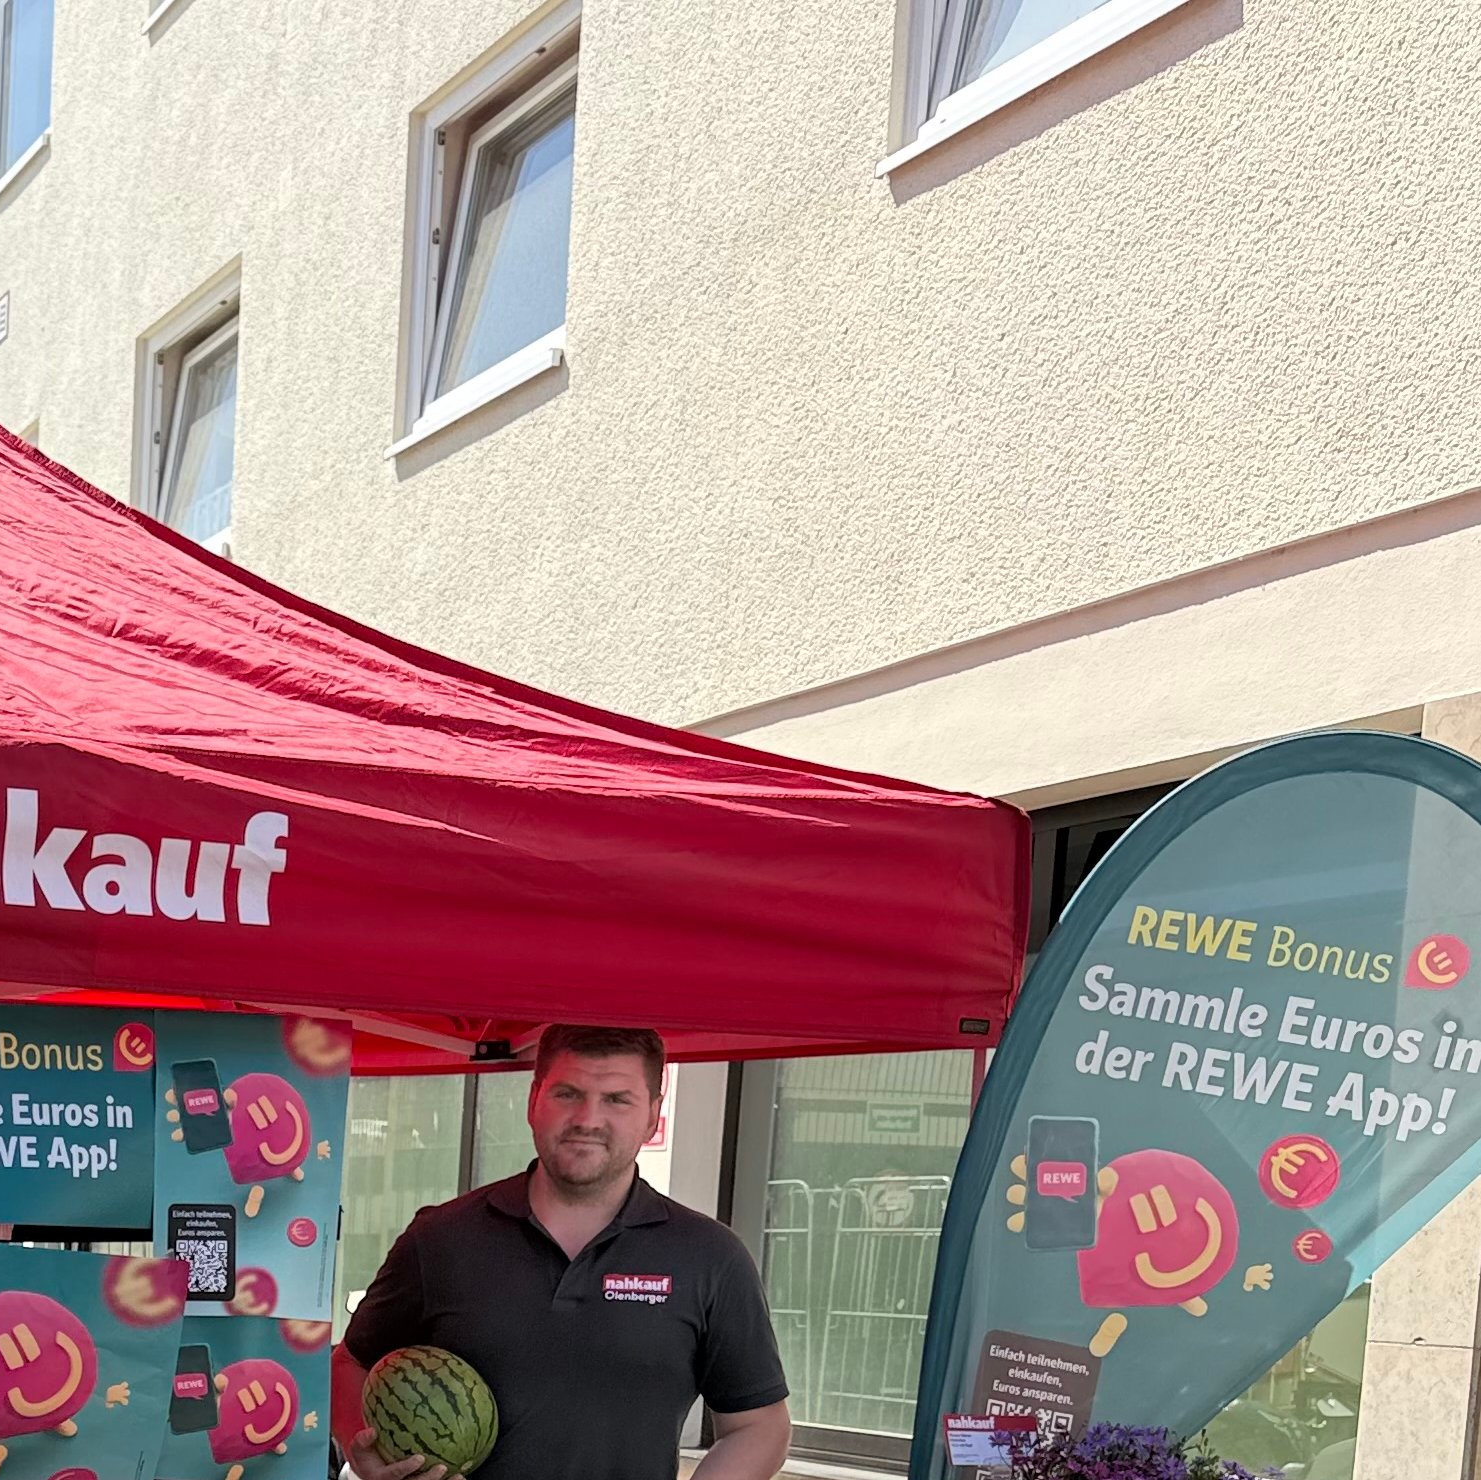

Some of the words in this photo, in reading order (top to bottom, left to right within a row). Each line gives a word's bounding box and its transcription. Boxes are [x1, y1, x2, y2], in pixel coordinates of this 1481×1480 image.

[1126, 904, 1258, 962] REWE
[1266, 924, 1394, 984] Bonus
[1078, 963, 1269, 1038] Sammle
[1277, 995, 1424, 1065] Euros
[1434, 1020, 1481, 1074] in
[1074, 1031, 1155, 1082] der
[1161, 1042, 1320, 1113] REWE
[1325, 1071, 1457, 1143] App!
[11, 1092, 99, 1129] Euros
[106, 1095, 133, 1129] in
[188, 1094, 216, 1108] REWE
[47, 1136, 118, 1178] App!
[1043, 1170, 1081, 1186] REWE
[605, 1277, 670, 1292] nahkauf
[989, 1345, 1026, 1363] Einfach
[176, 1377, 205, 1391] REWE
[1008, 1367, 1063, 1388] einkaufen,
[992, 1379, 1021, 1396] Euros
[1022, 1387, 1074, 1406] ansparen.
[947, 1415, 996, 1430] nahkauf
